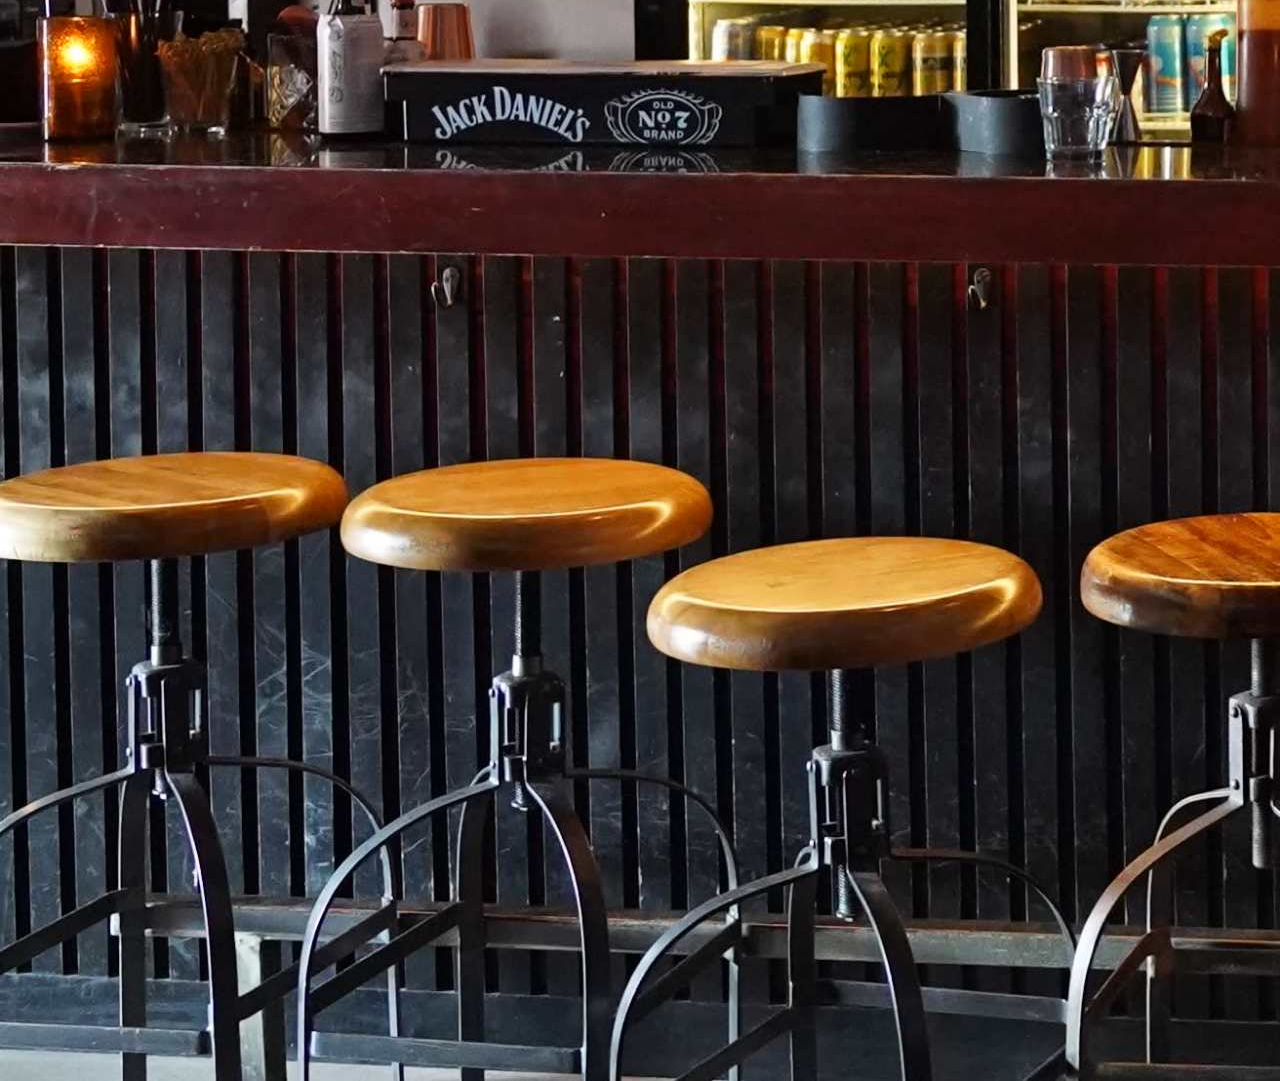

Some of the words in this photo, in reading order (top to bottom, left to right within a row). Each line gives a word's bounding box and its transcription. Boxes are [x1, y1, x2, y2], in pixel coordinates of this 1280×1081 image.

[653, 101, 674, 109] OLD
[432, 94, 493, 140] JACK
[493, 86, 591, 143] DANIEL'S
[643, 130, 685, 140] BRAND
